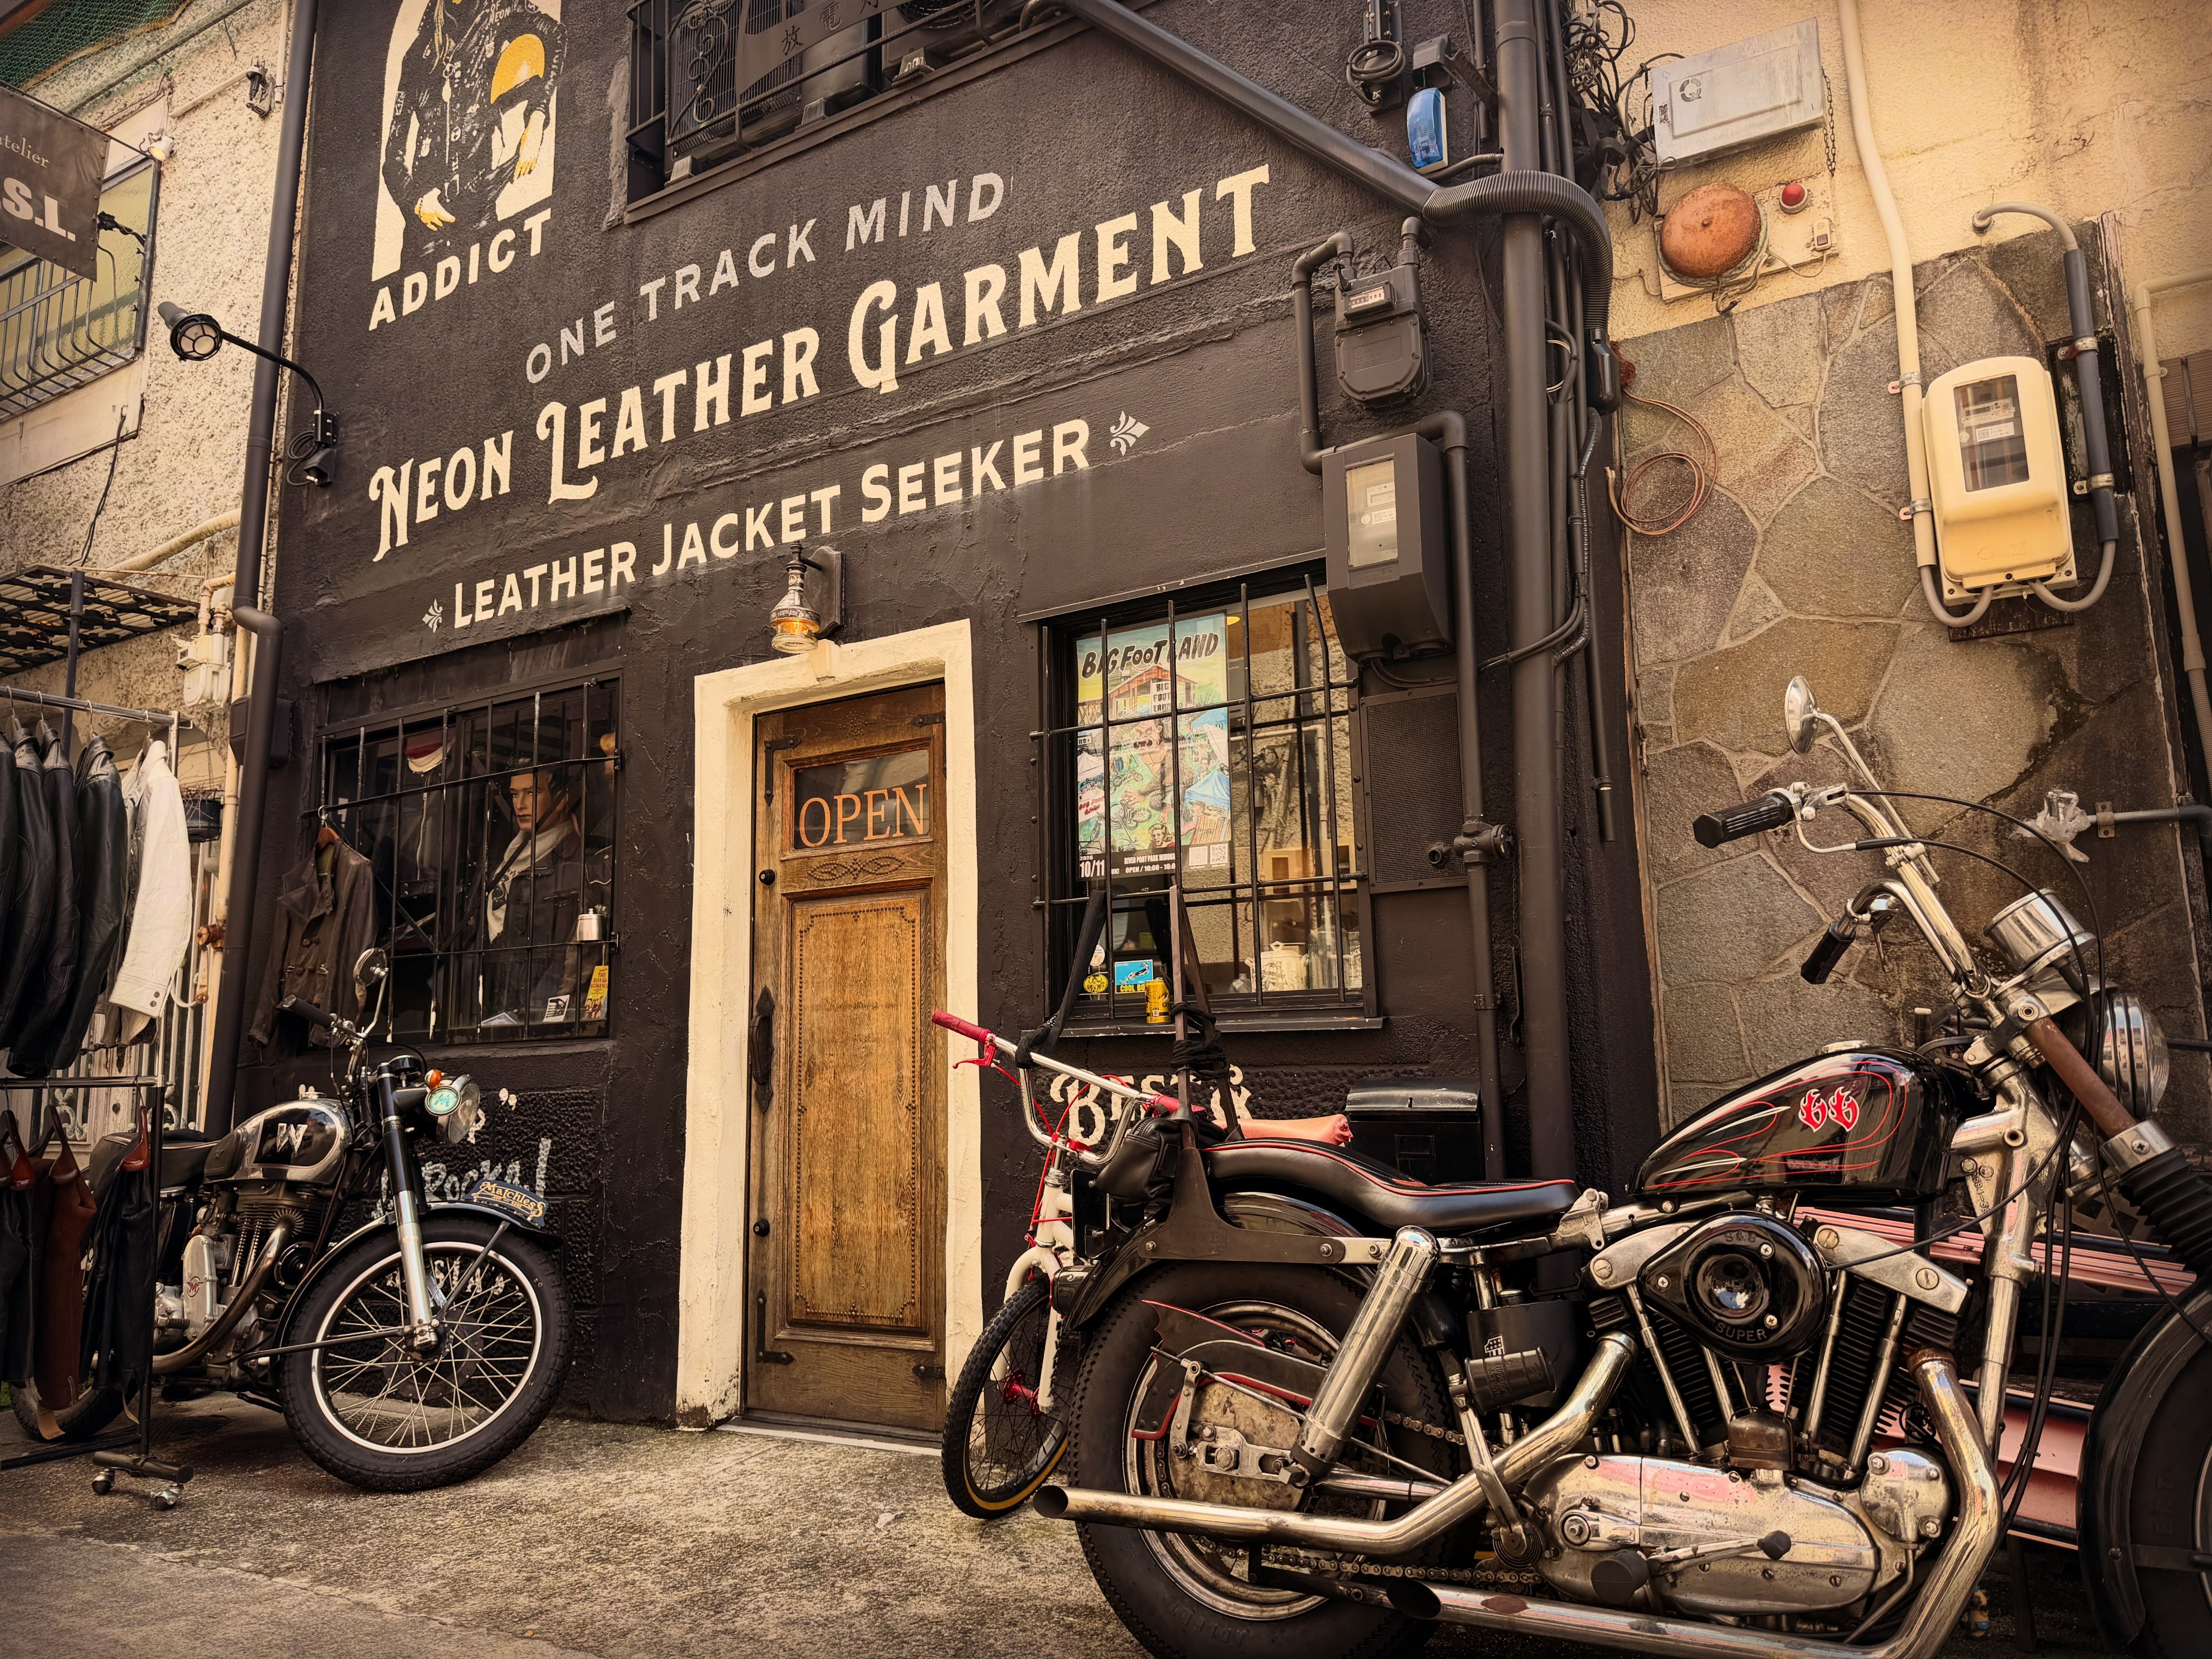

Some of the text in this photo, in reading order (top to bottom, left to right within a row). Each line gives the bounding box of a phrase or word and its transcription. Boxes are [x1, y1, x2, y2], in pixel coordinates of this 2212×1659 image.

[0, 135, 50, 168] telier
[369, 208, 551, 331] ADDICT
[526, 172, 1004, 383] ONE TRACK MIND
[369, 164, 1270, 562] NEON LEATHER GARMENT
[454, 419, 1090, 629] LEATHER JACKET SEEKER
[1082, 648, 1119, 678] BIG
[1156, 683, 1169, 692] BIG
[799, 784, 928, 848] OPEN
[1079, 859, 1105, 878] 10/11
[1124, 857, 1136, 865] RIVER
[1148, 854, 1159, 862] PARK
[1125, 866, 1139, 874] OPEN
[1120, 984, 1136, 992] COOL
[1715, 1322, 1768, 1341] SUPER
